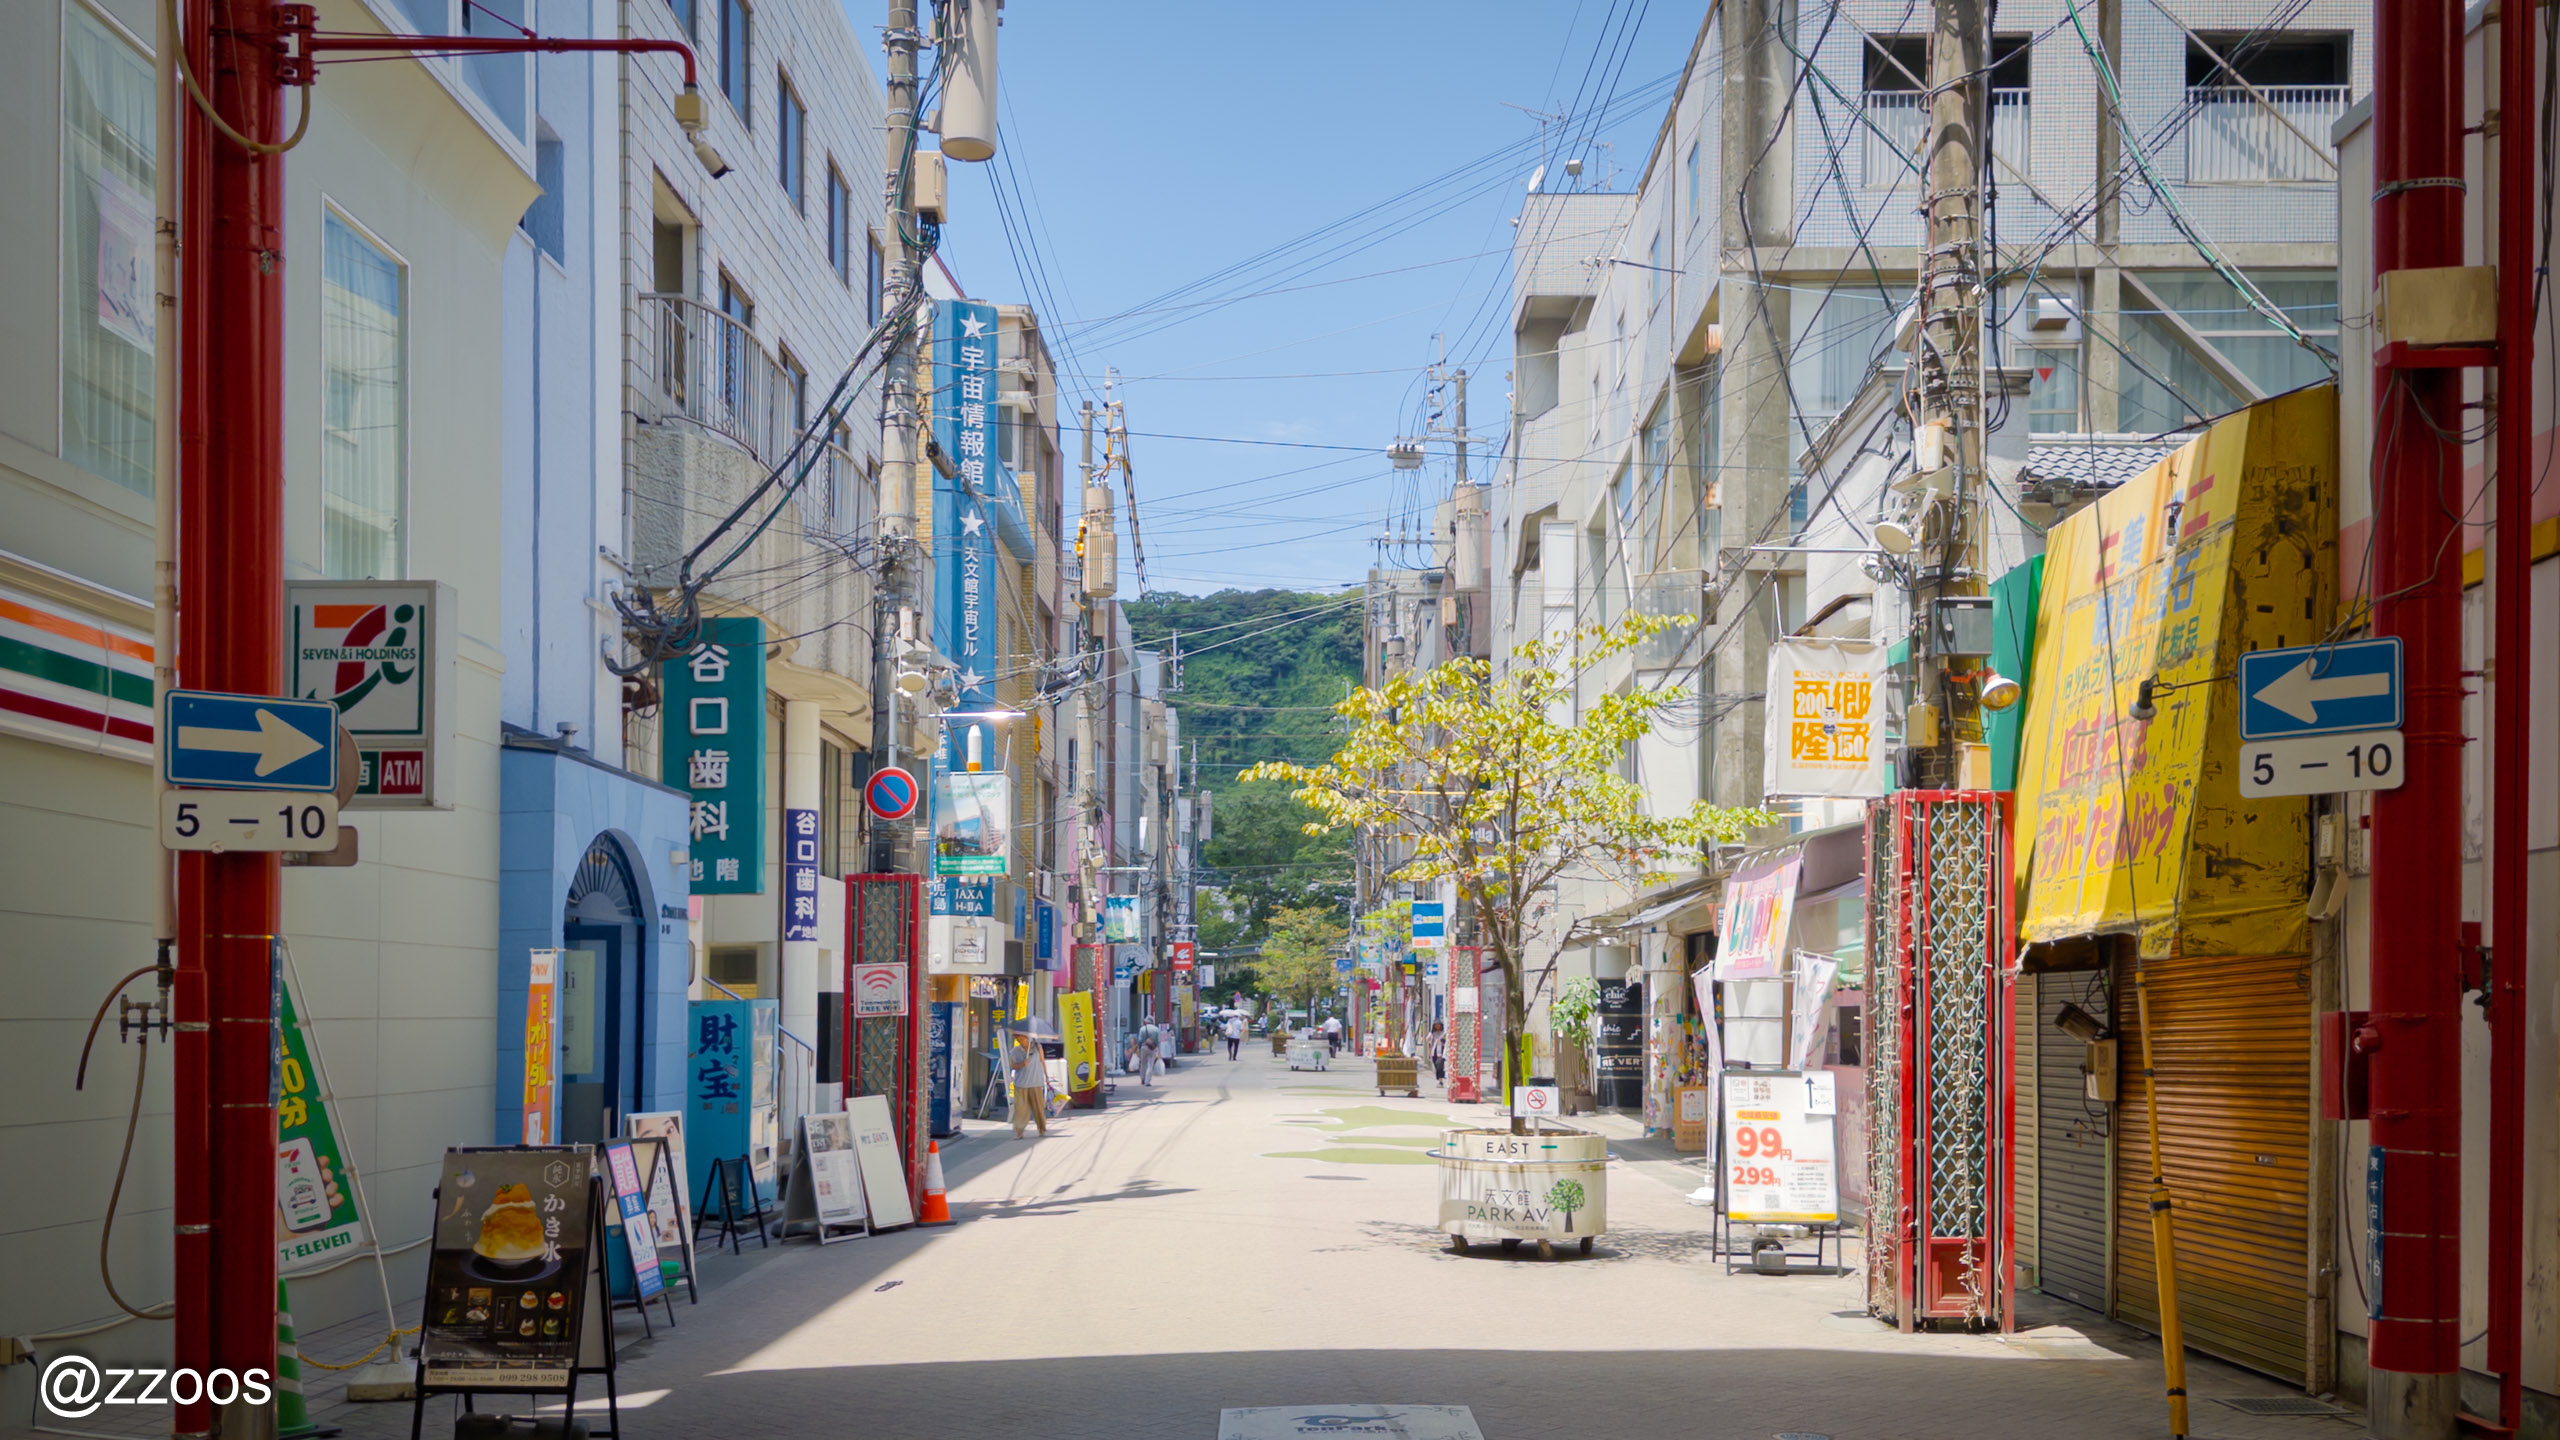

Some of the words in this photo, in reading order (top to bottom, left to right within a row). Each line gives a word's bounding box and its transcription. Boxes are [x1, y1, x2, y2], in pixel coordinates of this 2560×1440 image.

[960, 346, 985, 487] 宇宙情報館
[963, 547, 979, 657] 天文館宇宙ビル
[355, 646, 417, 661] HOLDINGS
[2155, 614, 2201, 665] 化粧品
[688, 643, 730, 842] 谷口歯科
[383, 760, 423, 788] ATM
[2252, 753, 2275, 786] 5
[2346, 743, 2393, 778] 10
[175, 803, 200, 838] 5
[278, 805, 326, 839] 10
[794, 811, 816, 920] 谷口歯科
[955, 887, 984, 900] JAXA
[697, 1012, 738, 1101] 財宝
[1486, 1141, 1530, 1154] EAST
[1467, 1205, 1516, 1222] PARK
[1522, 1207, 1551, 1223] AV.
[1485, 1188, 1531, 1206] 天文館
[280, 1230, 352, 1262] 7-ELEVEN
[2367, 1258, 2381, 1277] 16
